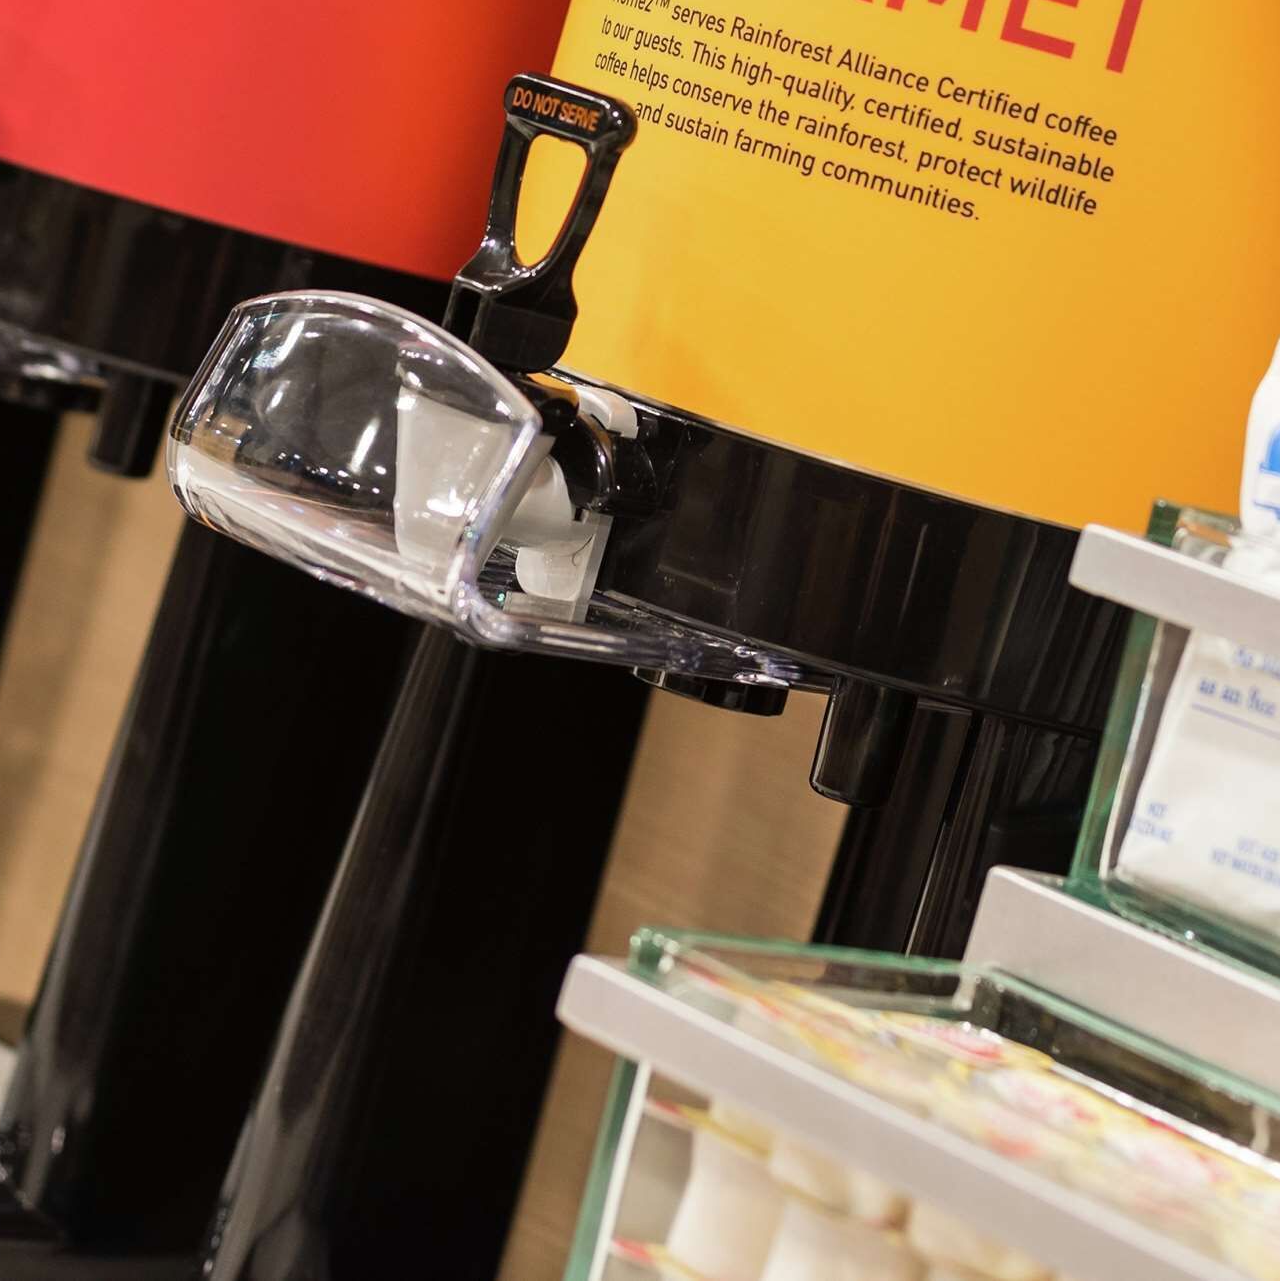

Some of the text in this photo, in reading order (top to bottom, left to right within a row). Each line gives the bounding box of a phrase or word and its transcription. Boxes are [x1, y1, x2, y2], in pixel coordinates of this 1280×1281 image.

[513, 88, 600, 131] DO NOT SERVE
[594, 50, 1097, 215] coffee helps conserve the rainforest, protect wildlife
[601, 15, 1114, 182] to our guests. This high-quality, certified, sustainable
[671, 3, 726, 34] serves
[730, 16, 833, 65] Rainforest
[837, 48, 930, 92] Alliance
[937, 76, 1040, 123] Certified
[1044, 112, 1117, 146] coffee
[634, 101, 979, 220] and sustain farming communities.
